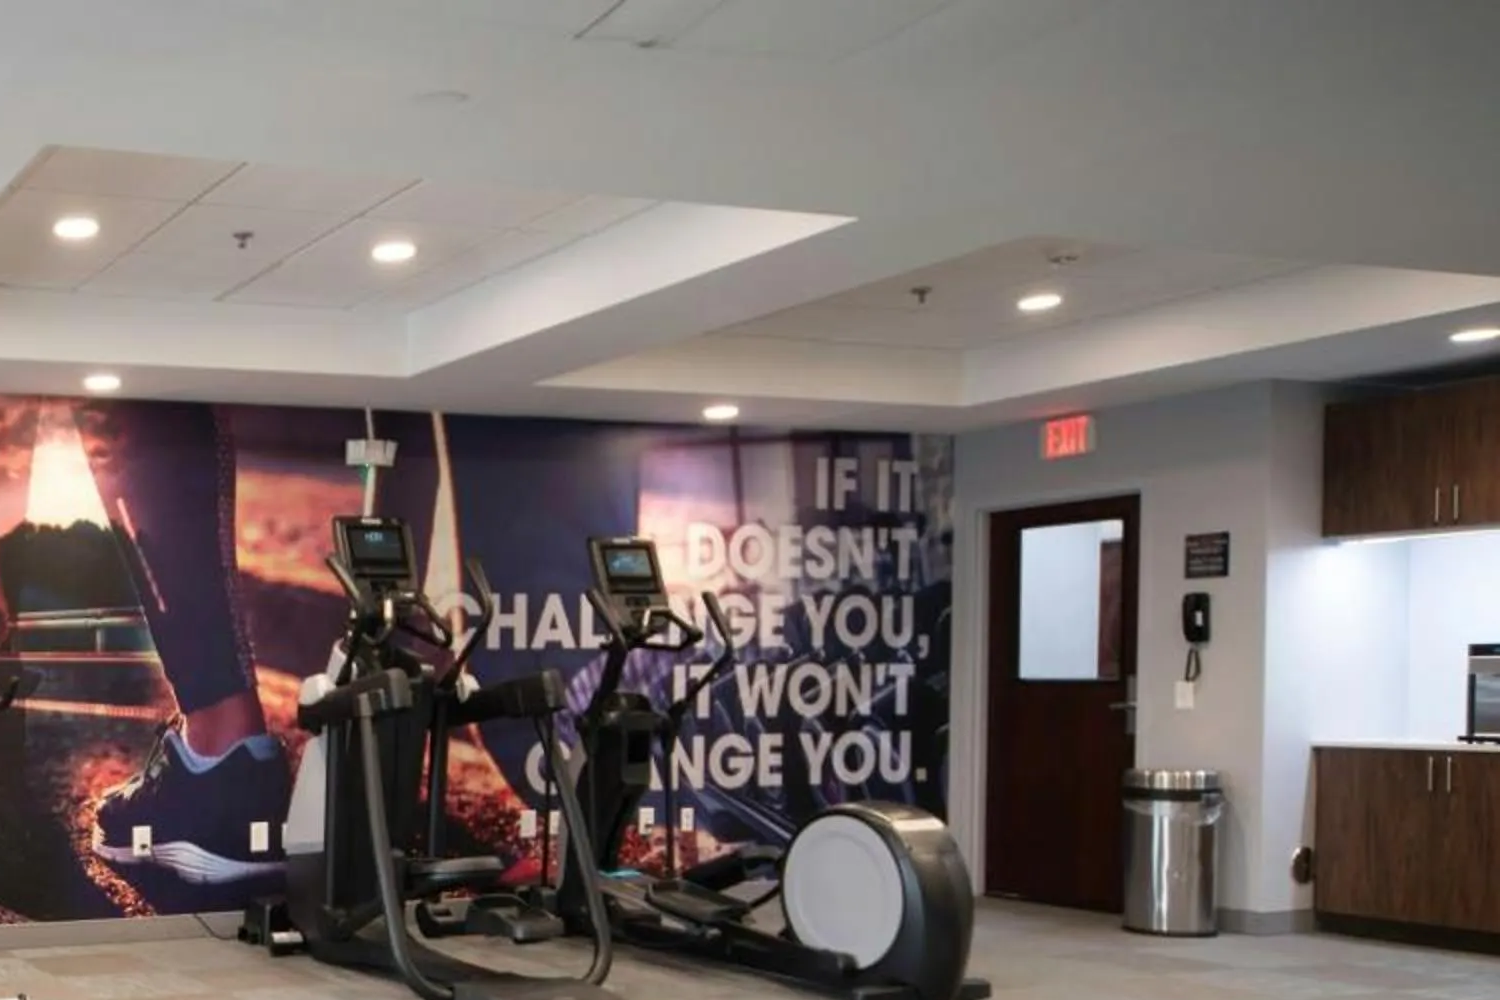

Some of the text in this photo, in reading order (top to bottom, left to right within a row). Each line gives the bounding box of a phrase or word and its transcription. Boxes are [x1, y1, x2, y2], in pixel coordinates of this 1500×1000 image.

[1046, 416, 1088, 459] EXIT
[815, 456, 918, 512] IF IT
[687, 522, 918, 581] DOESN'T
[437, 592, 930, 659] CHALNGE YOU,
[673, 662, 916, 719] IT WON'T
[525, 730, 928, 796] CNGE YOU.
